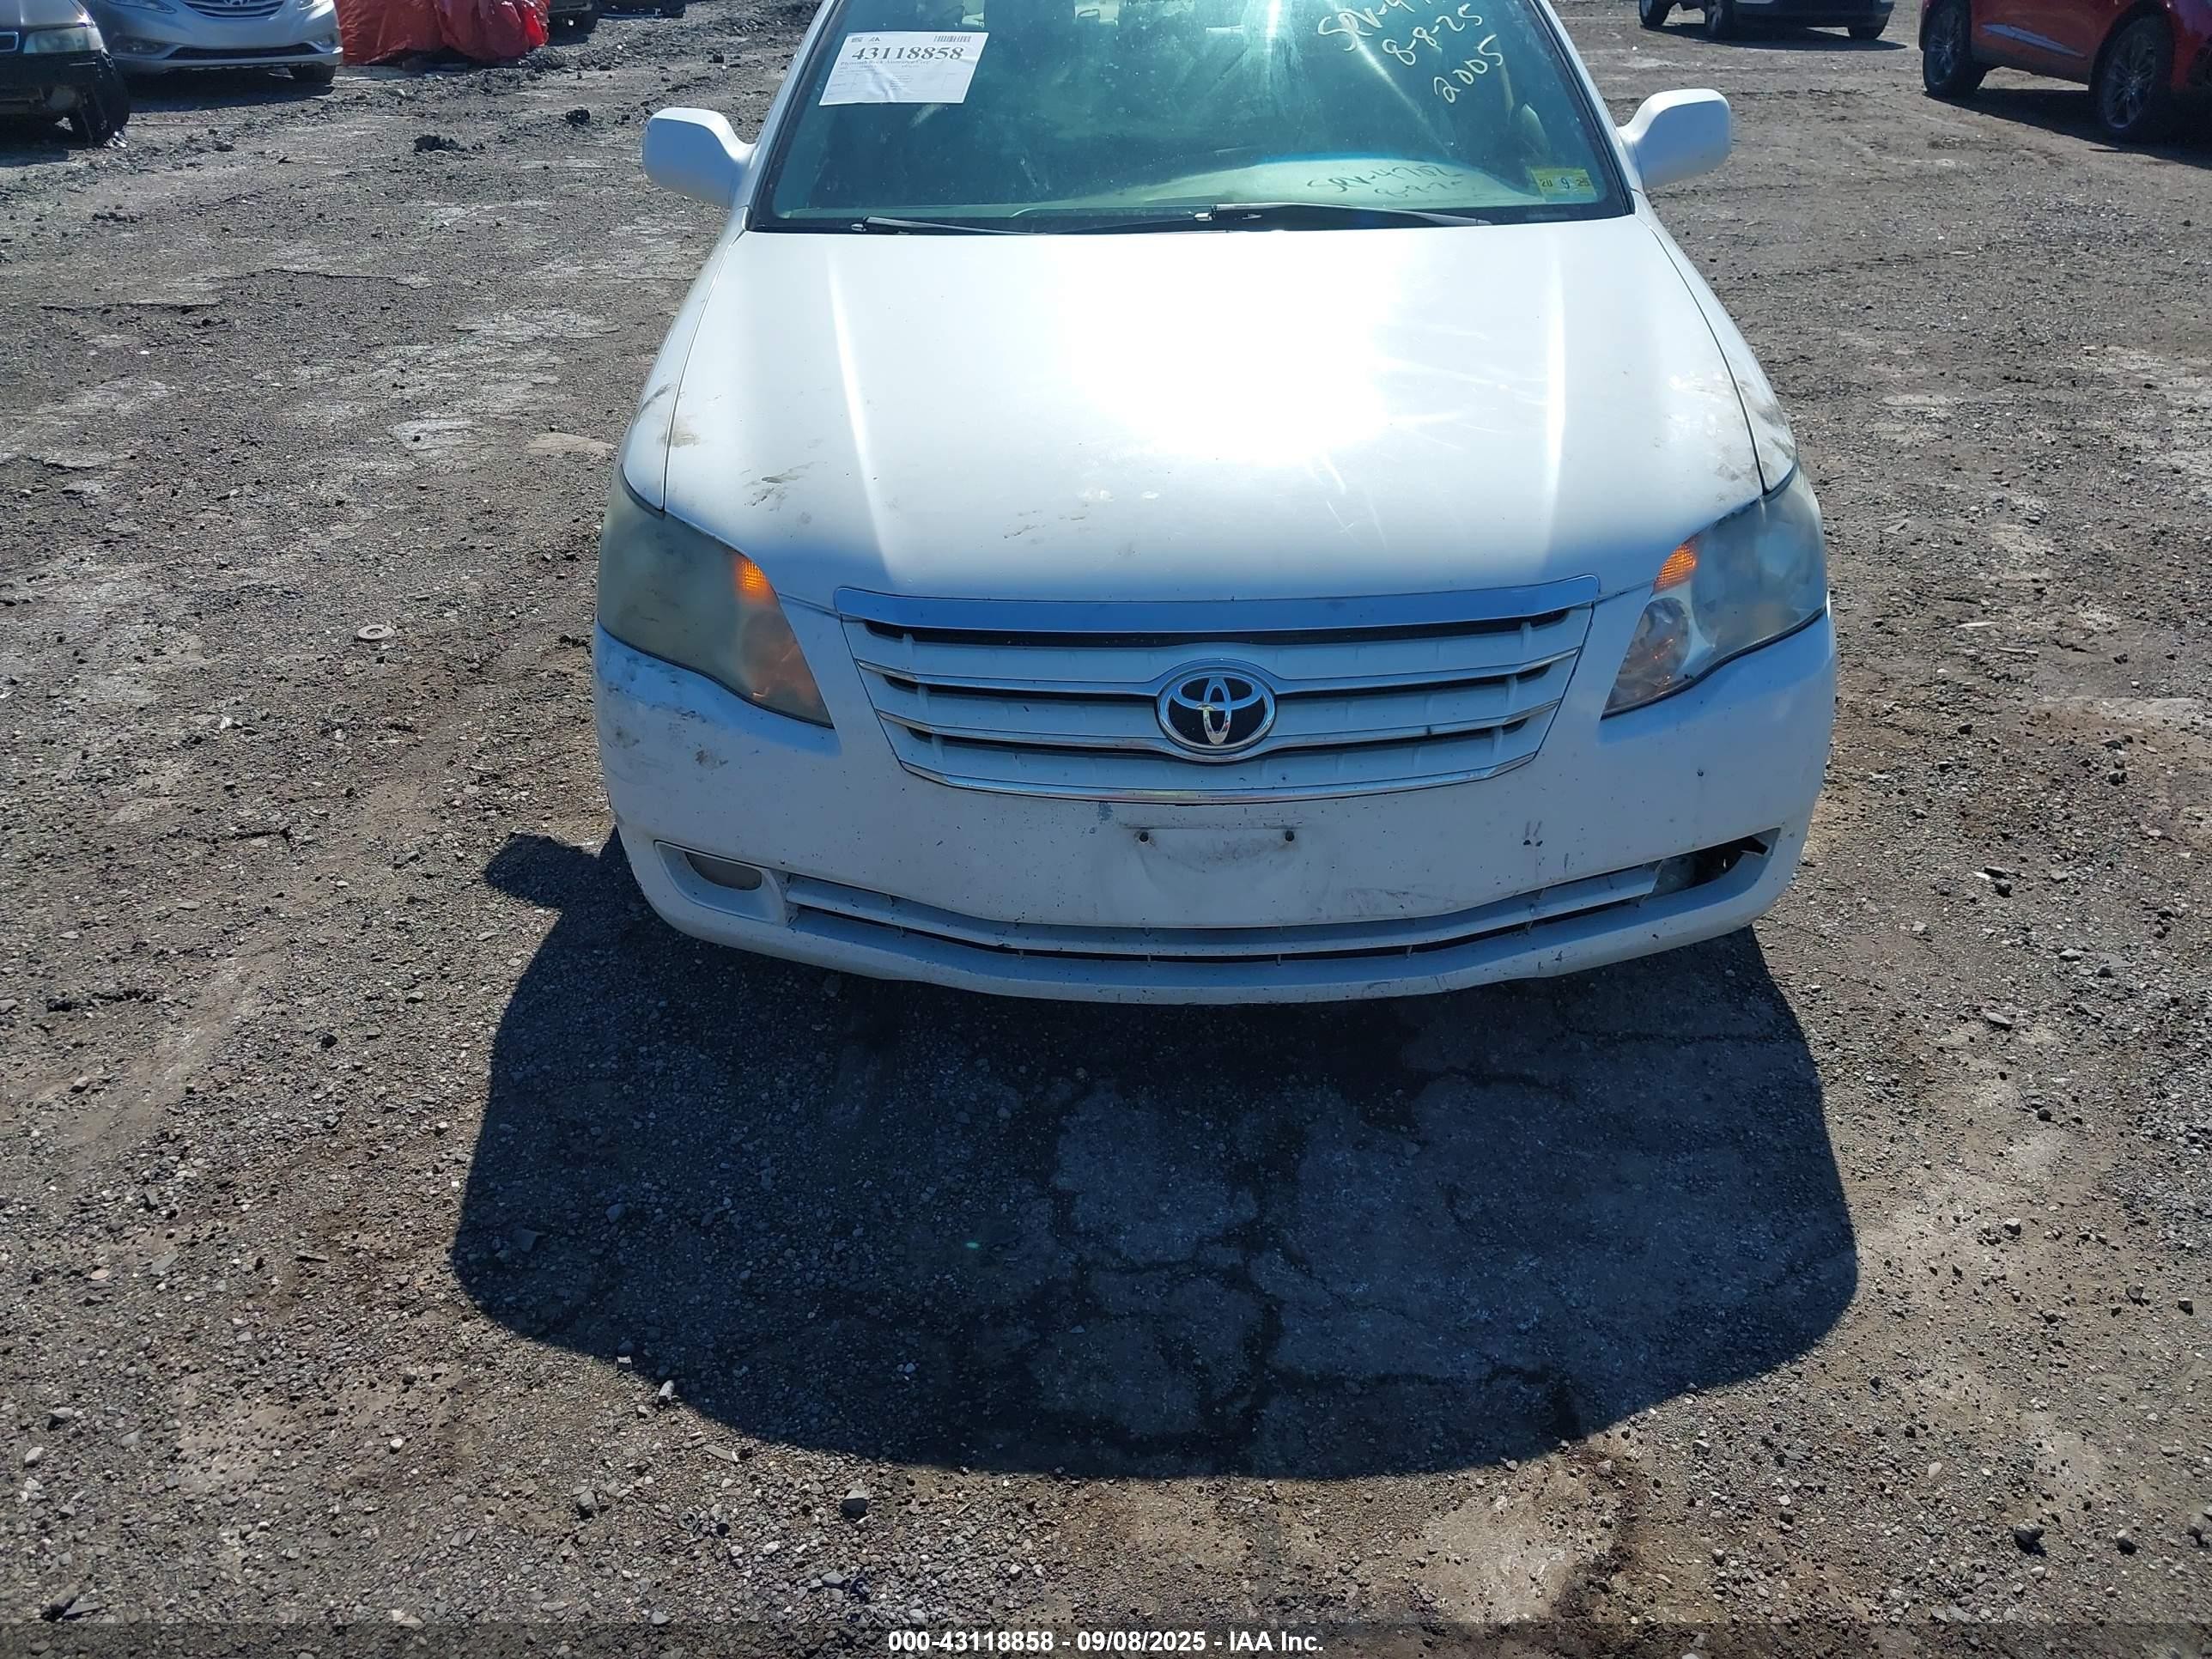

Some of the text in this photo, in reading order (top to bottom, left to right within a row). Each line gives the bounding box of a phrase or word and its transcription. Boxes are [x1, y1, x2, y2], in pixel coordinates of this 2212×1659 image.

[851, 46, 964, 60] 43118858
[1382, 3, 1483, 66] 8-8-25
[1433, 33, 1504, 104] 2005
[1560, 177, 1571, 190] 9
